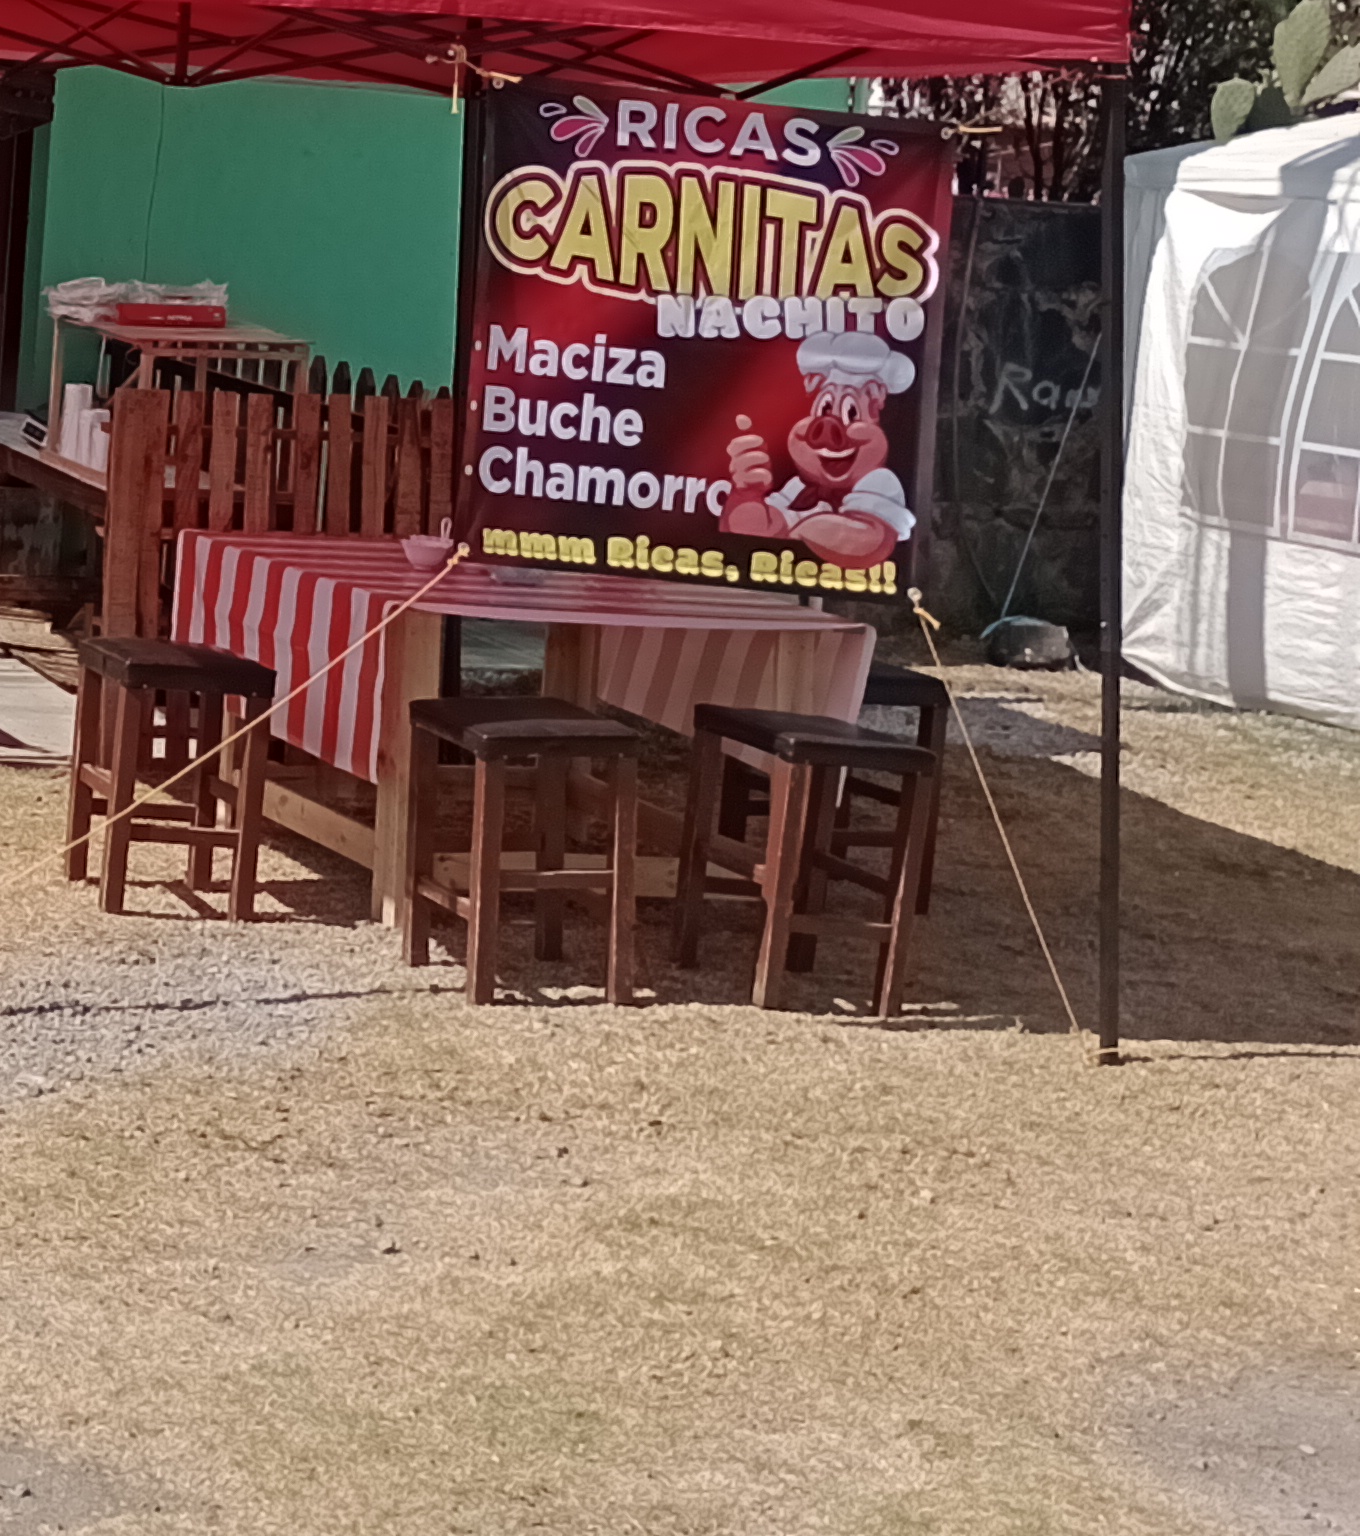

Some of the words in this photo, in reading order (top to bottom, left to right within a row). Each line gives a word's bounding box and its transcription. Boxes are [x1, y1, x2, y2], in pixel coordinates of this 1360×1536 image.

[617, 99, 821, 166] RICAS
[490, 167, 932, 301] CARNITAS
[657, 295, 926, 341] NACHITO
[486, 324, 666, 389] Maciza
[482, 385, 643, 446] Buche
[482, 528, 597, 566] mmm
[607, 535, 741, 583] Ricas,
[750, 550, 898, 595] Ricas!!
